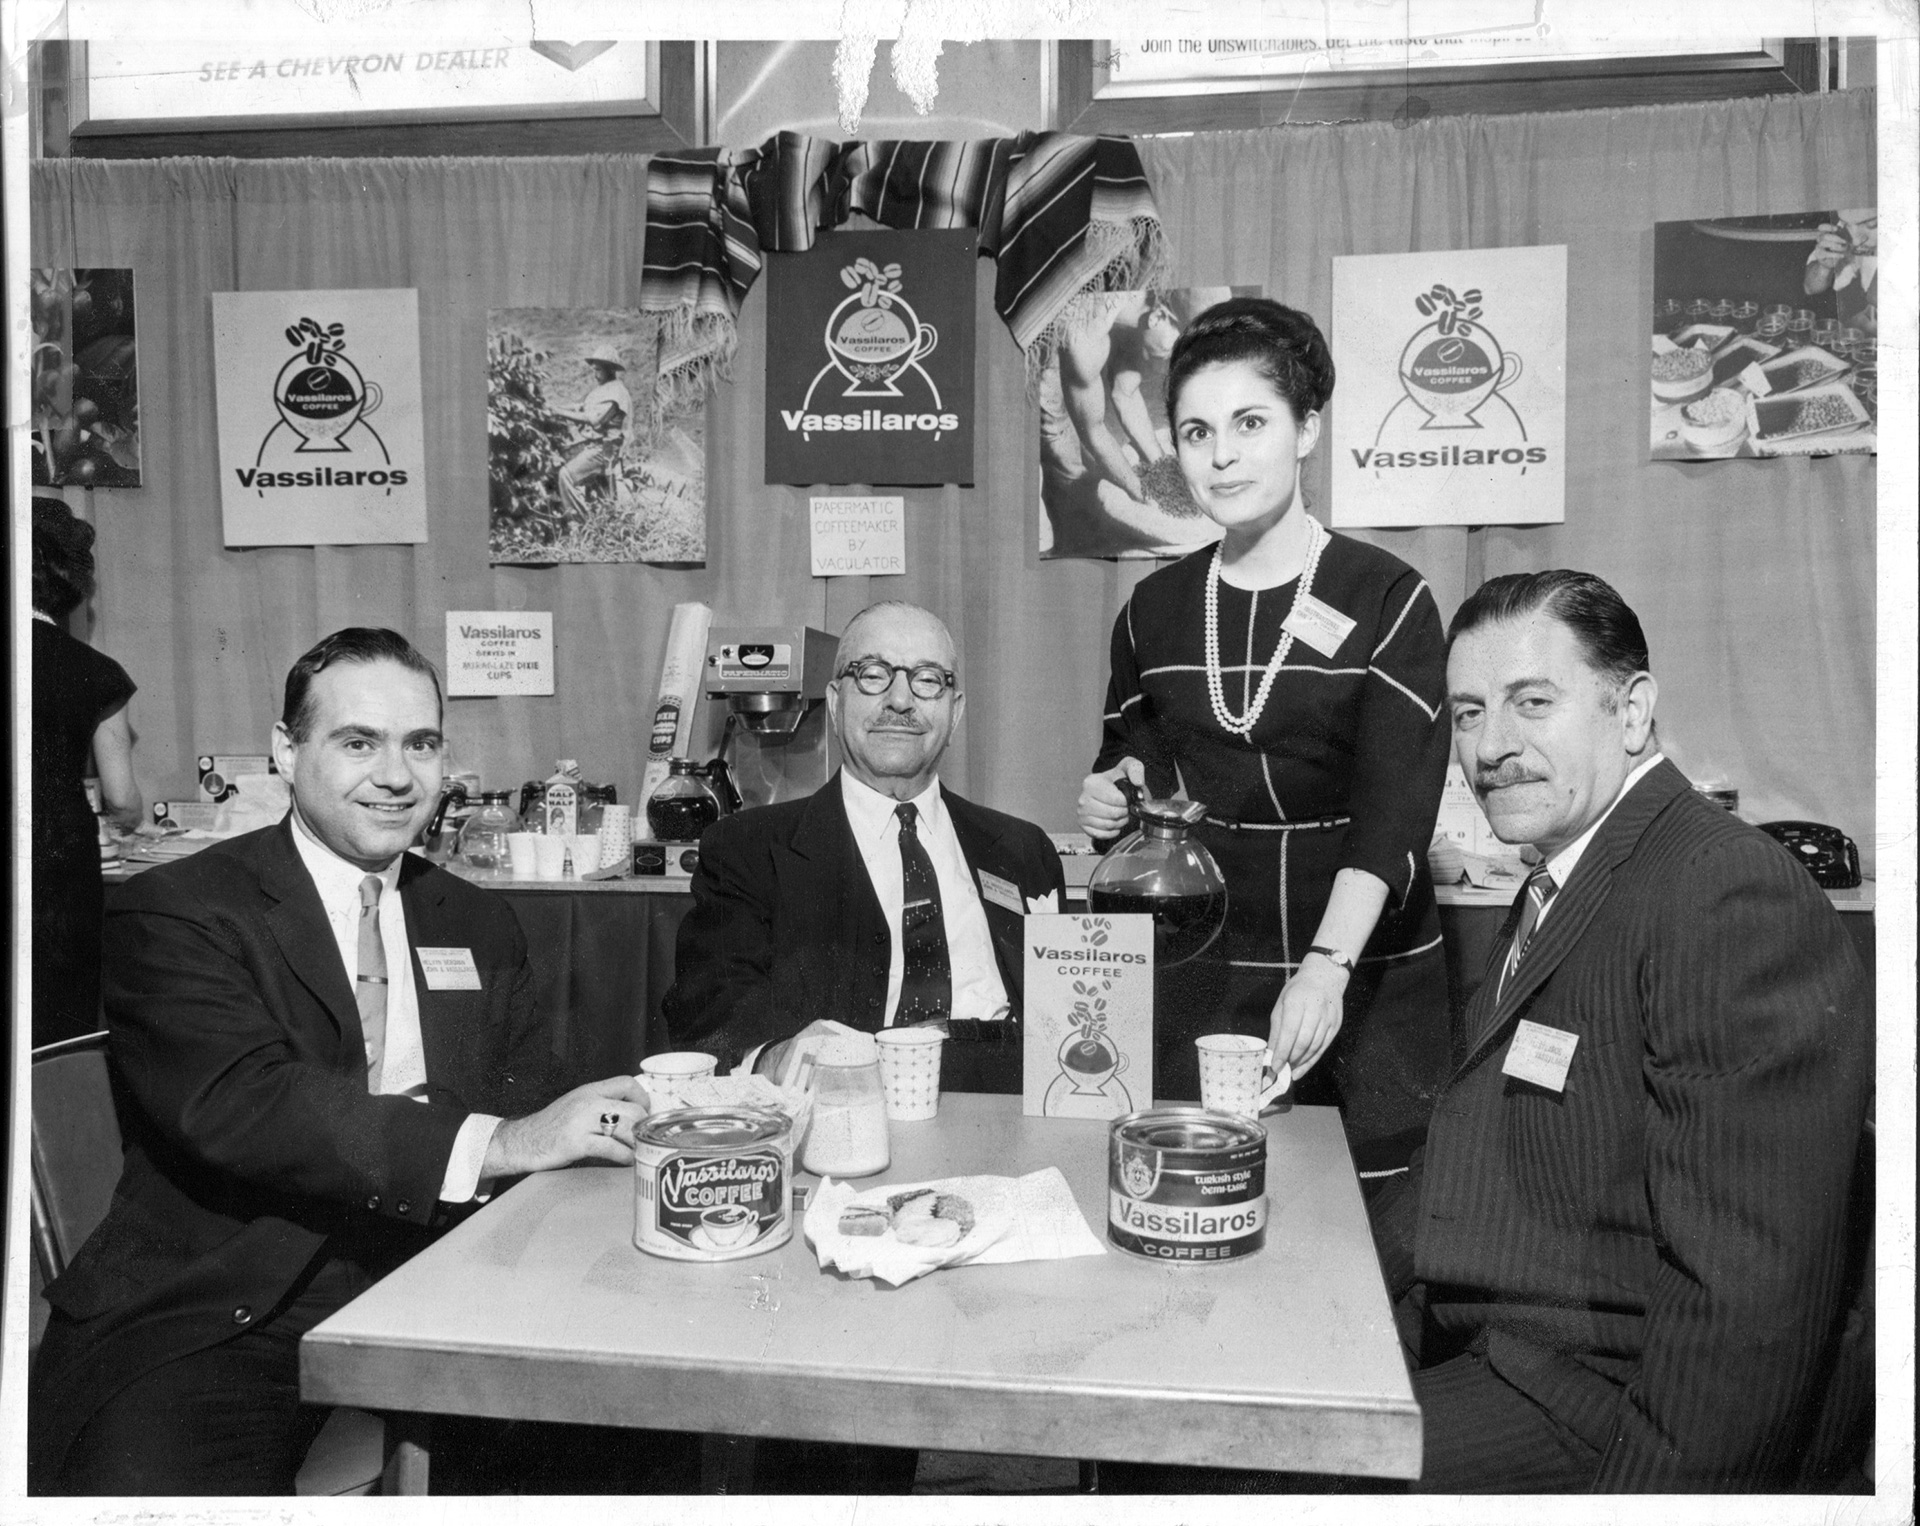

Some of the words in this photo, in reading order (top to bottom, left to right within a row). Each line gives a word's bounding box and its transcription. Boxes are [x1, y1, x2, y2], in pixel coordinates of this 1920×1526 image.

[1141, 39, 1171, 53] Join
[199, 60, 241, 82] SEE
[248, 59, 267, 80] A
[276, 52, 405, 78] CHEVRON
[415, 47, 511, 72] DEALER
[840, 336, 906, 344] Vassilaros
[1414, 366, 1488, 377] Vassilaros
[1430, 376, 1472, 385] COFFEE
[287, 393, 353, 402] Vassilaros
[780, 409, 959, 431] Vassilaros
[1350, 445, 1547, 469] Vassilaros
[235, 467, 408, 488] Vassilaros
[814, 501, 894, 515] PAPERMATIC
[815, 519, 898, 534] COFFEEMAKER
[848, 539, 867, 551] BY
[816, 557, 901, 570] VACULATOR
[459, 625, 542, 640] Vassilaros
[516, 661, 539, 670] DIXIE
[486, 671, 512, 680] CUPS
[1033, 946, 1147, 965] Vassilaros
[1057, 966, 1123, 977] COFFEE
[662, 1158, 778, 1204] Vassilaros
[685, 1182, 764, 1206] COFFEE
[1119, 1198, 1256, 1235] Vassilaros
[1143, 1243, 1231, 1258] COFFEE
